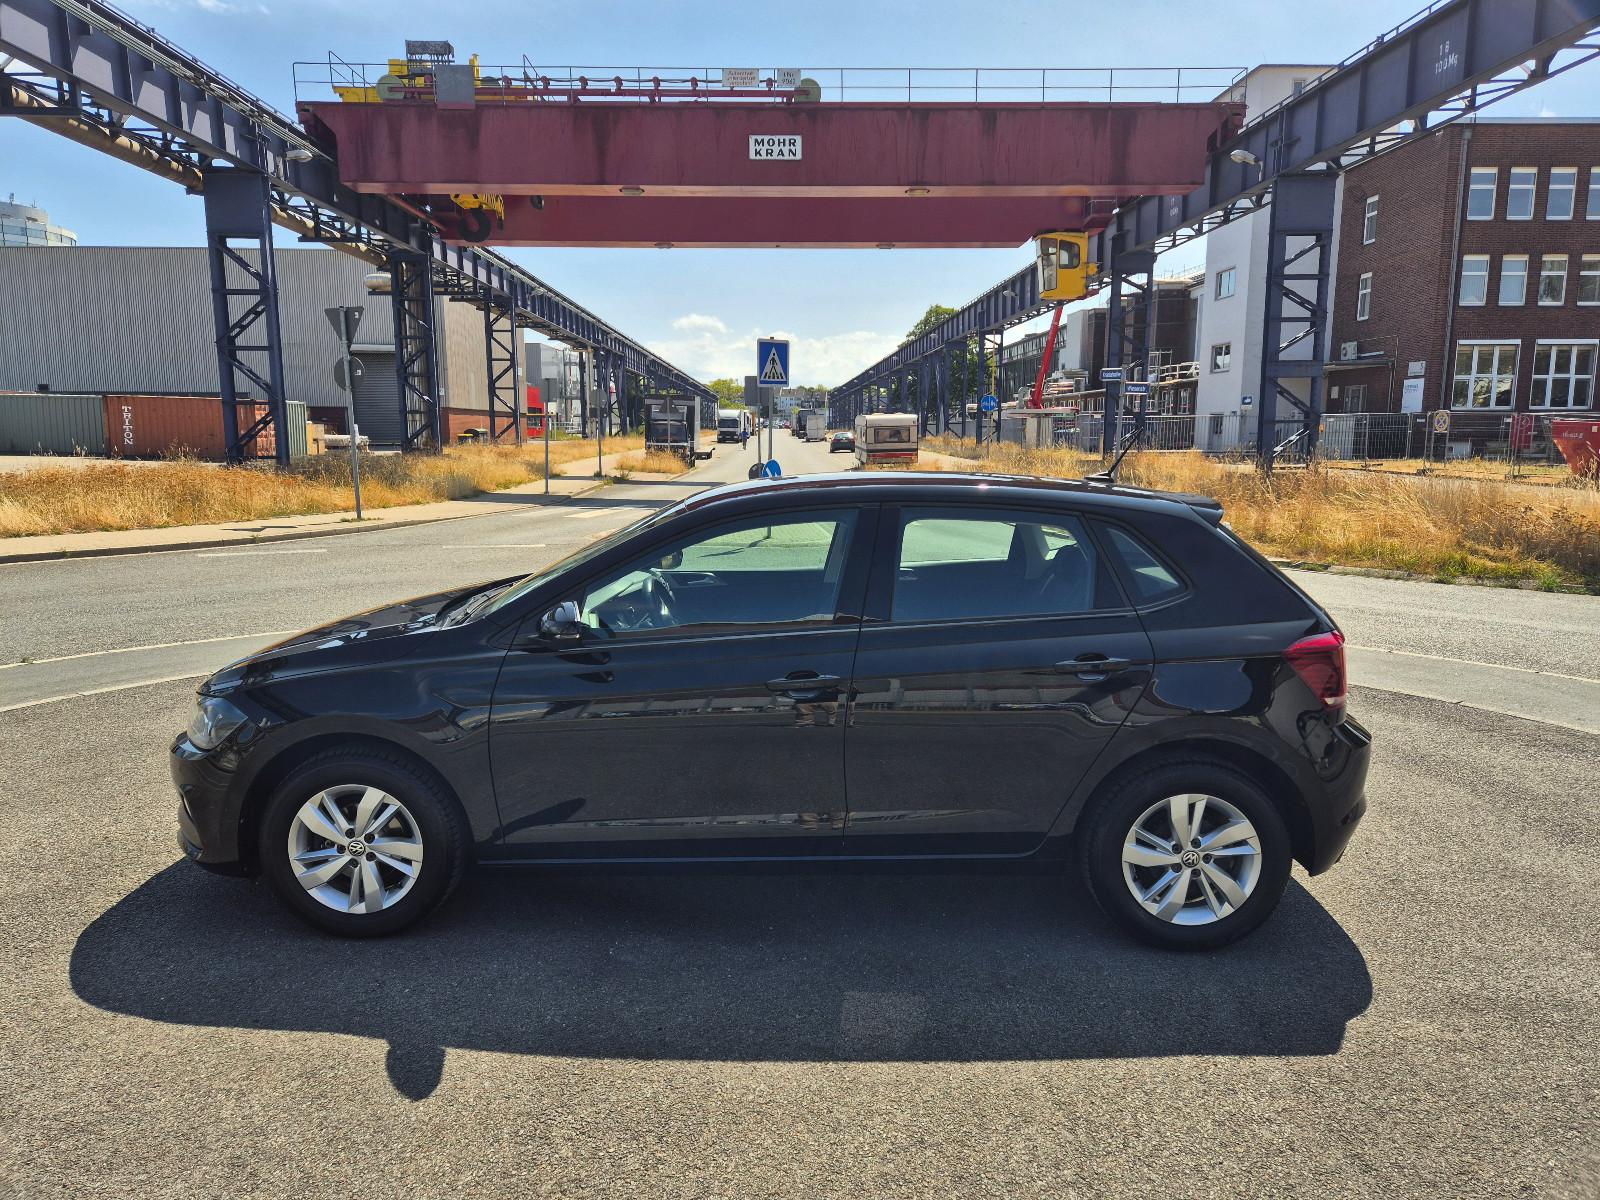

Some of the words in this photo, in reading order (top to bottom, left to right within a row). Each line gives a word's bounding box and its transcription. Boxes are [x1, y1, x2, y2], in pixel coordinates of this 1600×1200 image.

[754, 138, 797, 147] MOHR
[754, 148, 797, 157] KRAN
[121, 405, 134, 445] TRITON
